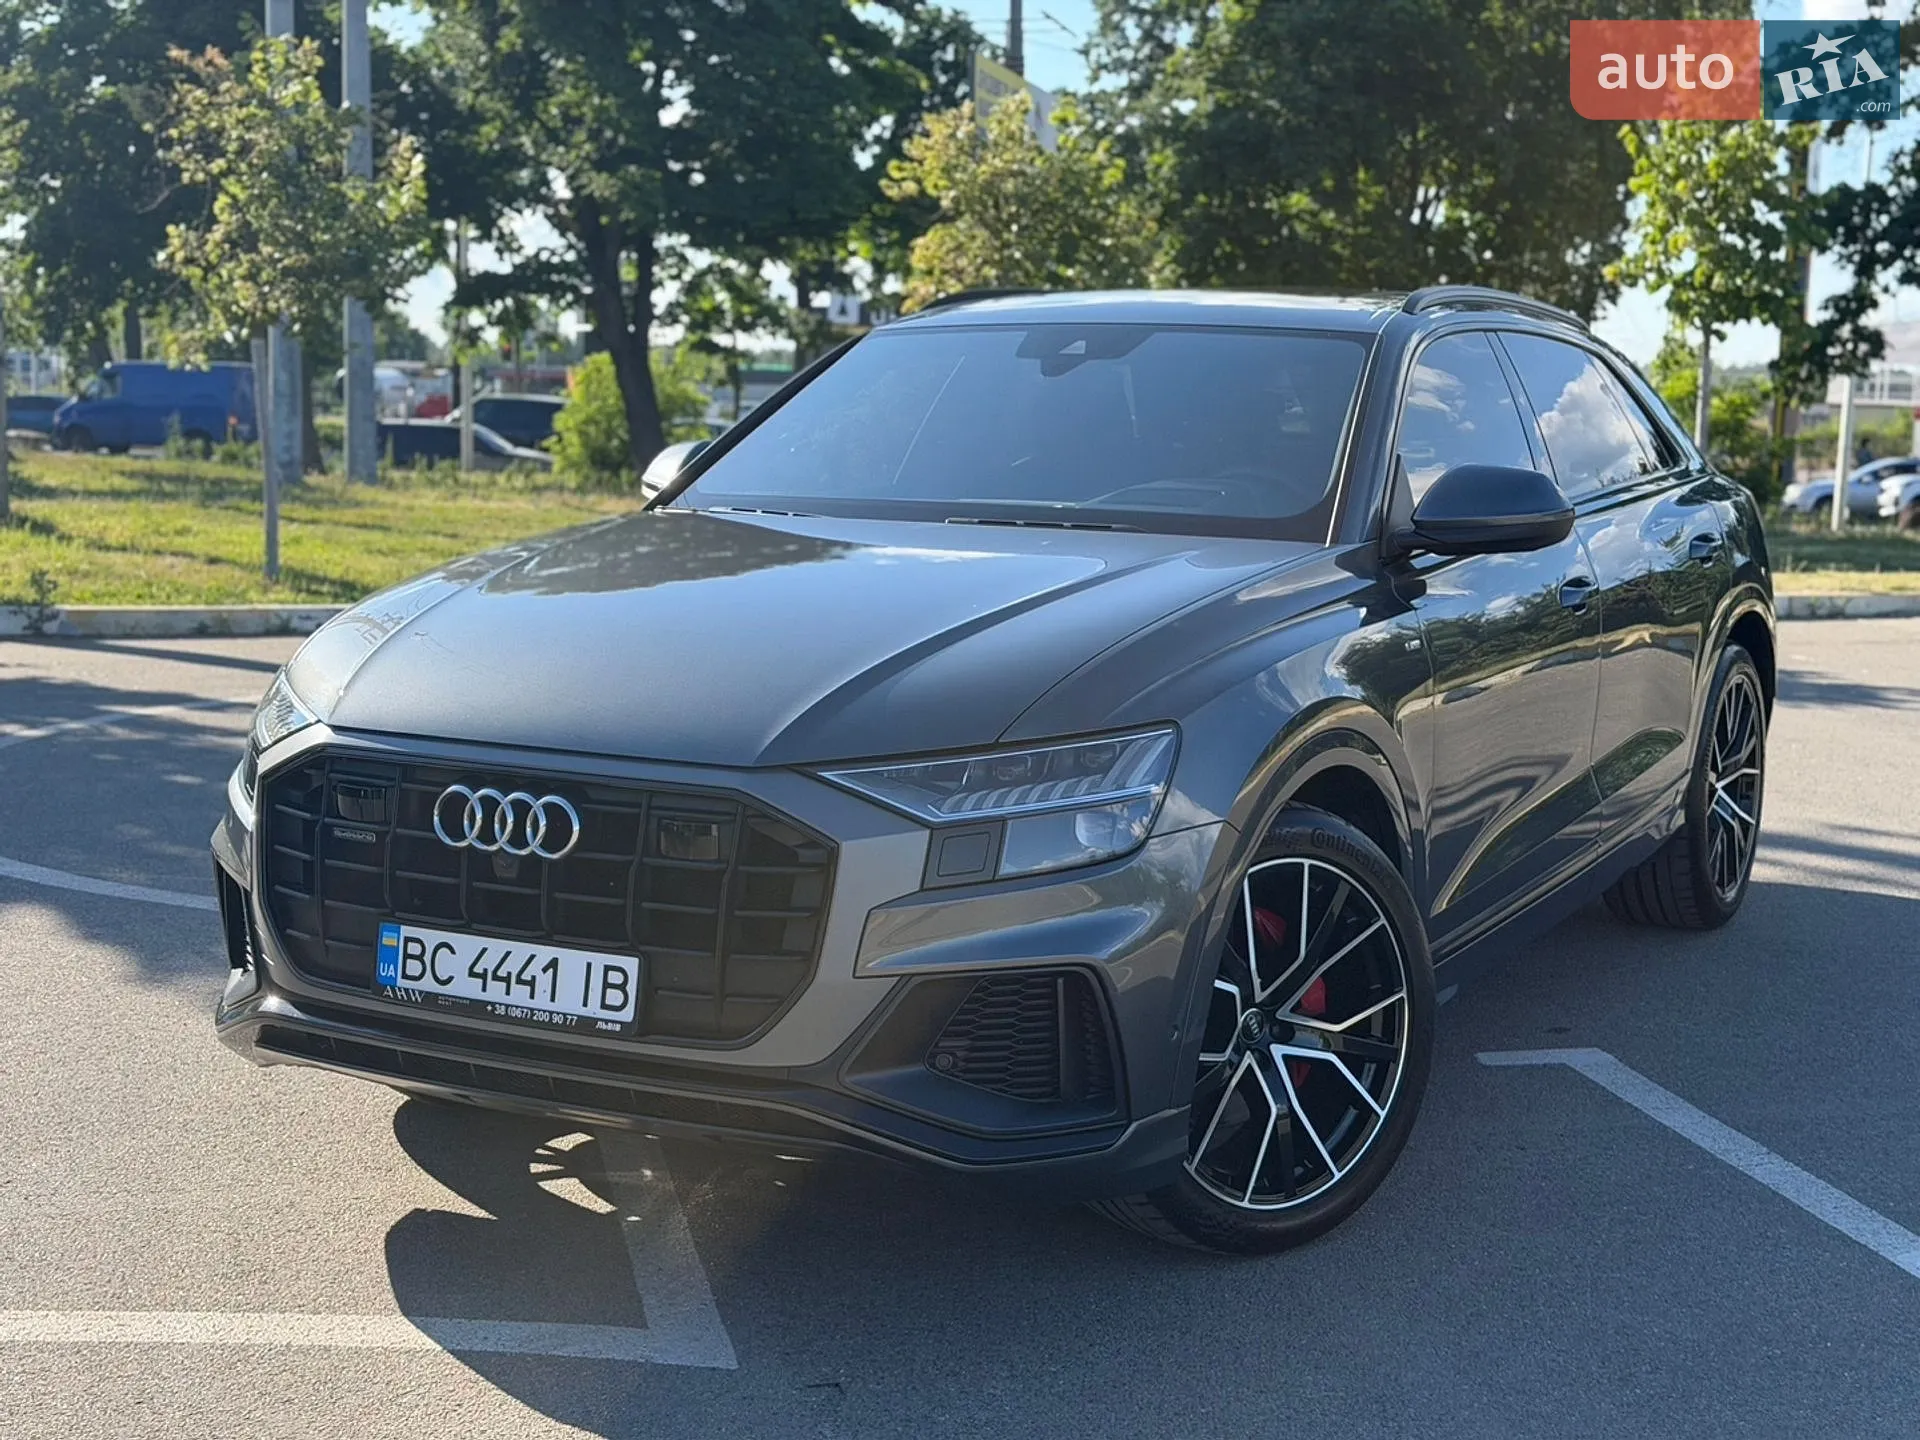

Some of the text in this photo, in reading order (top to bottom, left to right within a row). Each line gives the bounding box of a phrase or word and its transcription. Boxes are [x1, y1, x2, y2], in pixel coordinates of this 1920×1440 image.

[379, 962, 396, 978] UA
[401, 936, 630, 1013] BC 4441 IB
[382, 985, 425, 1004] AHW
[507, 1006, 531, 1019] (067)
[533, 1010, 550, 1022] 200
[552, 1013, 564, 1024] 90
[566, 1015, 578, 1026] 77
